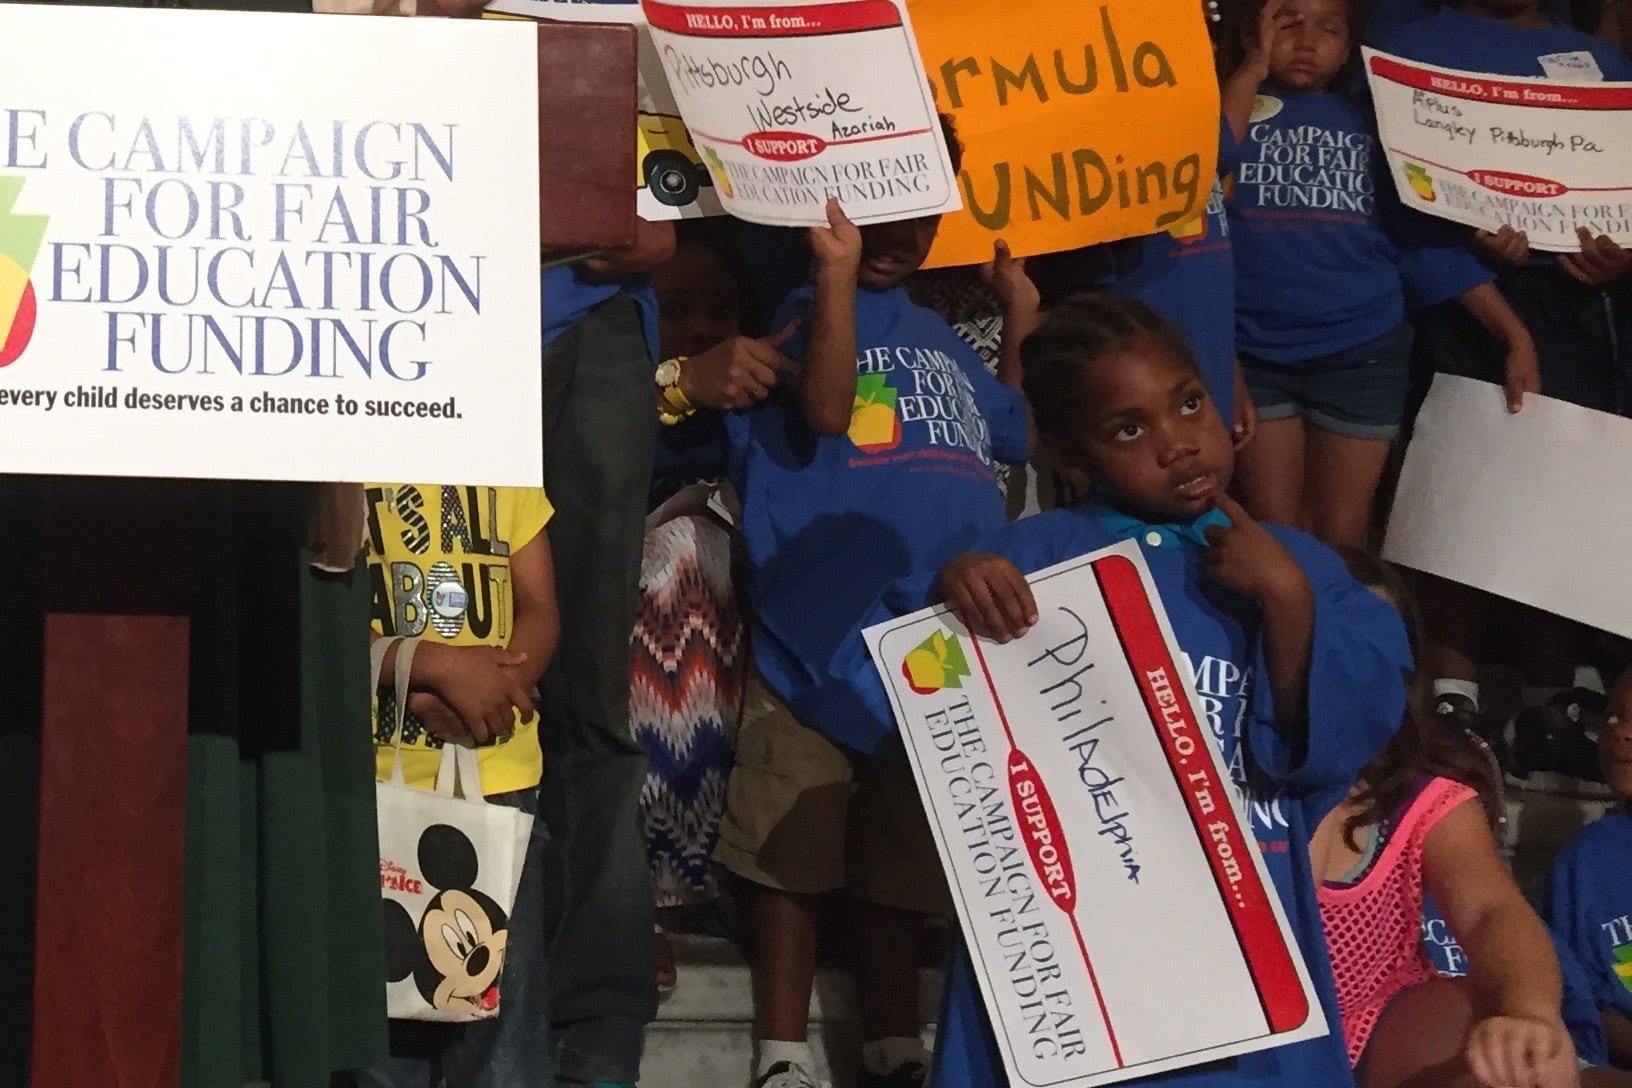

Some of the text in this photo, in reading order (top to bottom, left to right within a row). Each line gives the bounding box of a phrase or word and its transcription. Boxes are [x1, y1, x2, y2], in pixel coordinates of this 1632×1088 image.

[686, 14, 821, 31] HELLO, I'm from...
[664, 44, 792, 96] Pittsburgh
[1430, 76, 1579, 104] HELLO, I'm from...
[747, 88, 862, 134] Westside
[831, 116, 896, 140] Azariah
[67, 110, 460, 182] CAMPAIGN
[756, 140, 818, 154] SUPPORT
[832, 154, 928, 183] FOR FAIR
[97, 176, 440, 248] FOR FAIR
[1484, 176, 1559, 195] SUPPORT
[47, 241, 486, 315] EDUCATION
[101, 310, 433, 382] FUNDING
[63, 386, 118, 410] child
[123, 388, 225, 412] deserves
[230, 395, 244, 412] a
[249, 393, 330, 416] chance
[334, 396, 359, 416] to
[364, 395, 463, 419] succeed.
[441, 484, 509, 557] ALL
[1146, 666, 1246, 909] HELLO, I'm from...
[1016, 780, 1071, 899] SUPPORT
[924, 709, 1058, 1061] EDUCATION FUNDING
[947, 693, 1087, 1060] THE CAMPAIGN FOR FAIR
